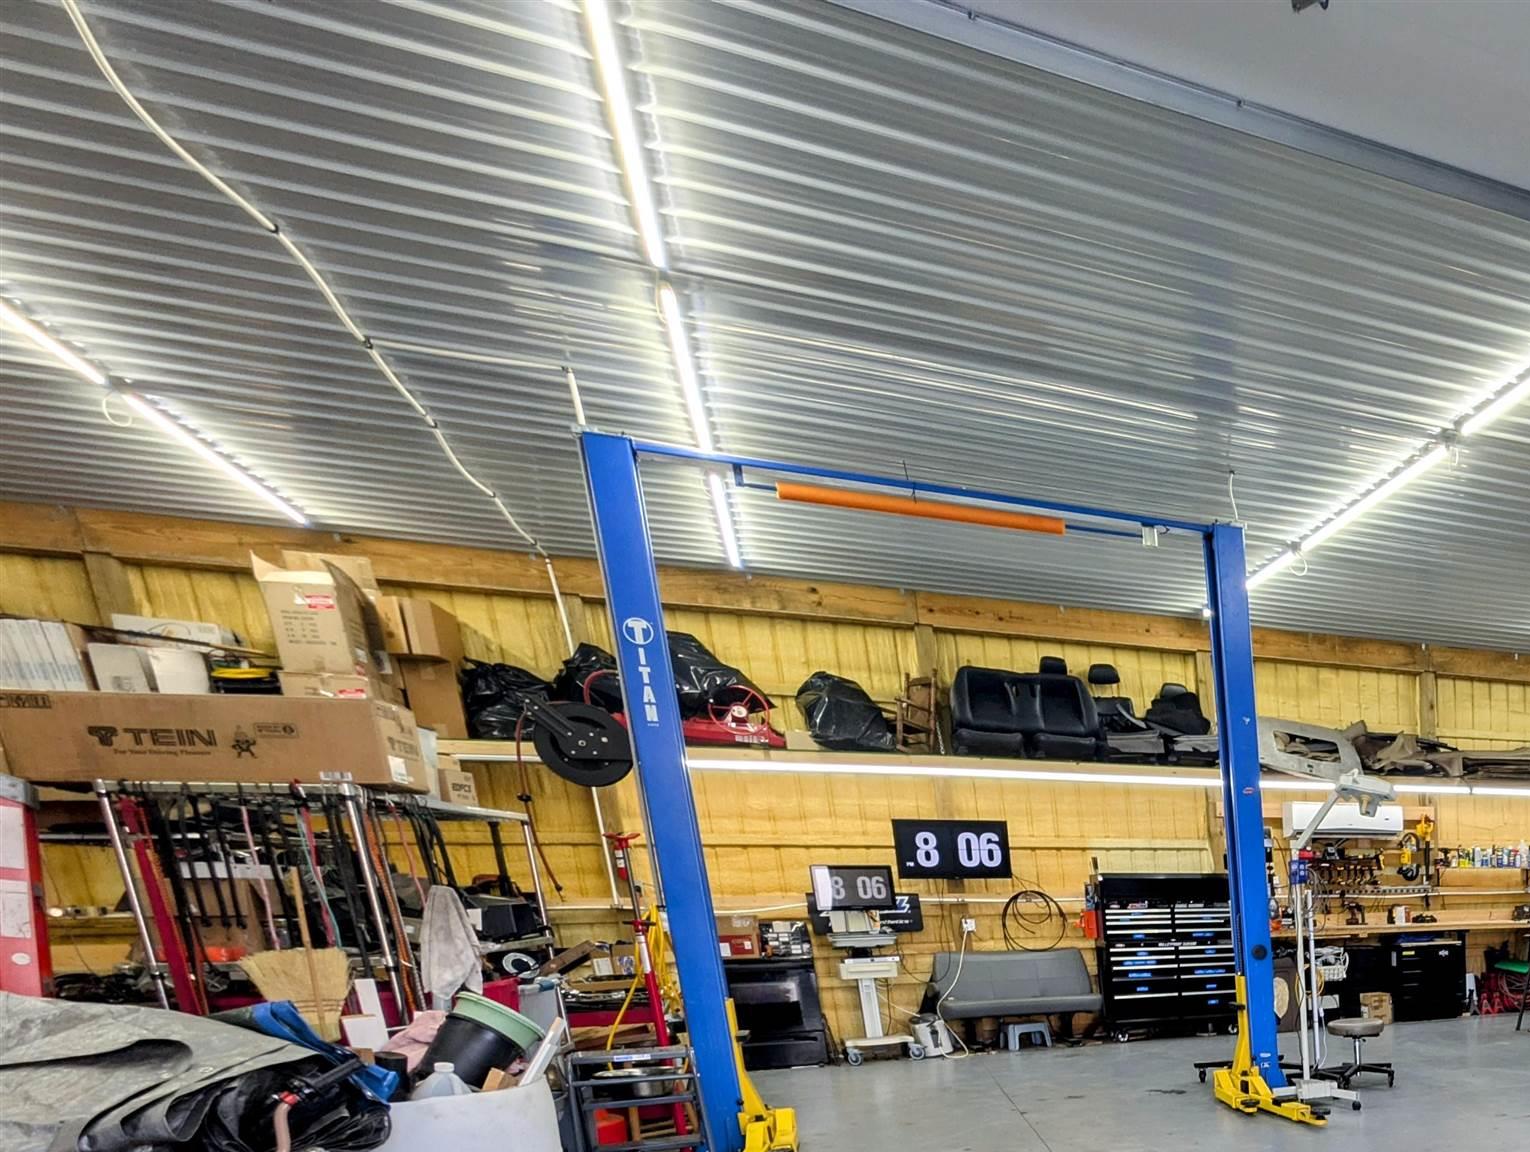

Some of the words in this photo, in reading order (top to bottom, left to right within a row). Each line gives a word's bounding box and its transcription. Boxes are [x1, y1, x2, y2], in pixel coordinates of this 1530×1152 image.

[627, 620, 659, 721] TITAN
[123, 727, 218, 747] TEIN
[914, 831, 940, 868] 8
[957, 831, 1002, 868] 06
[856, 876, 887, 900] 06
